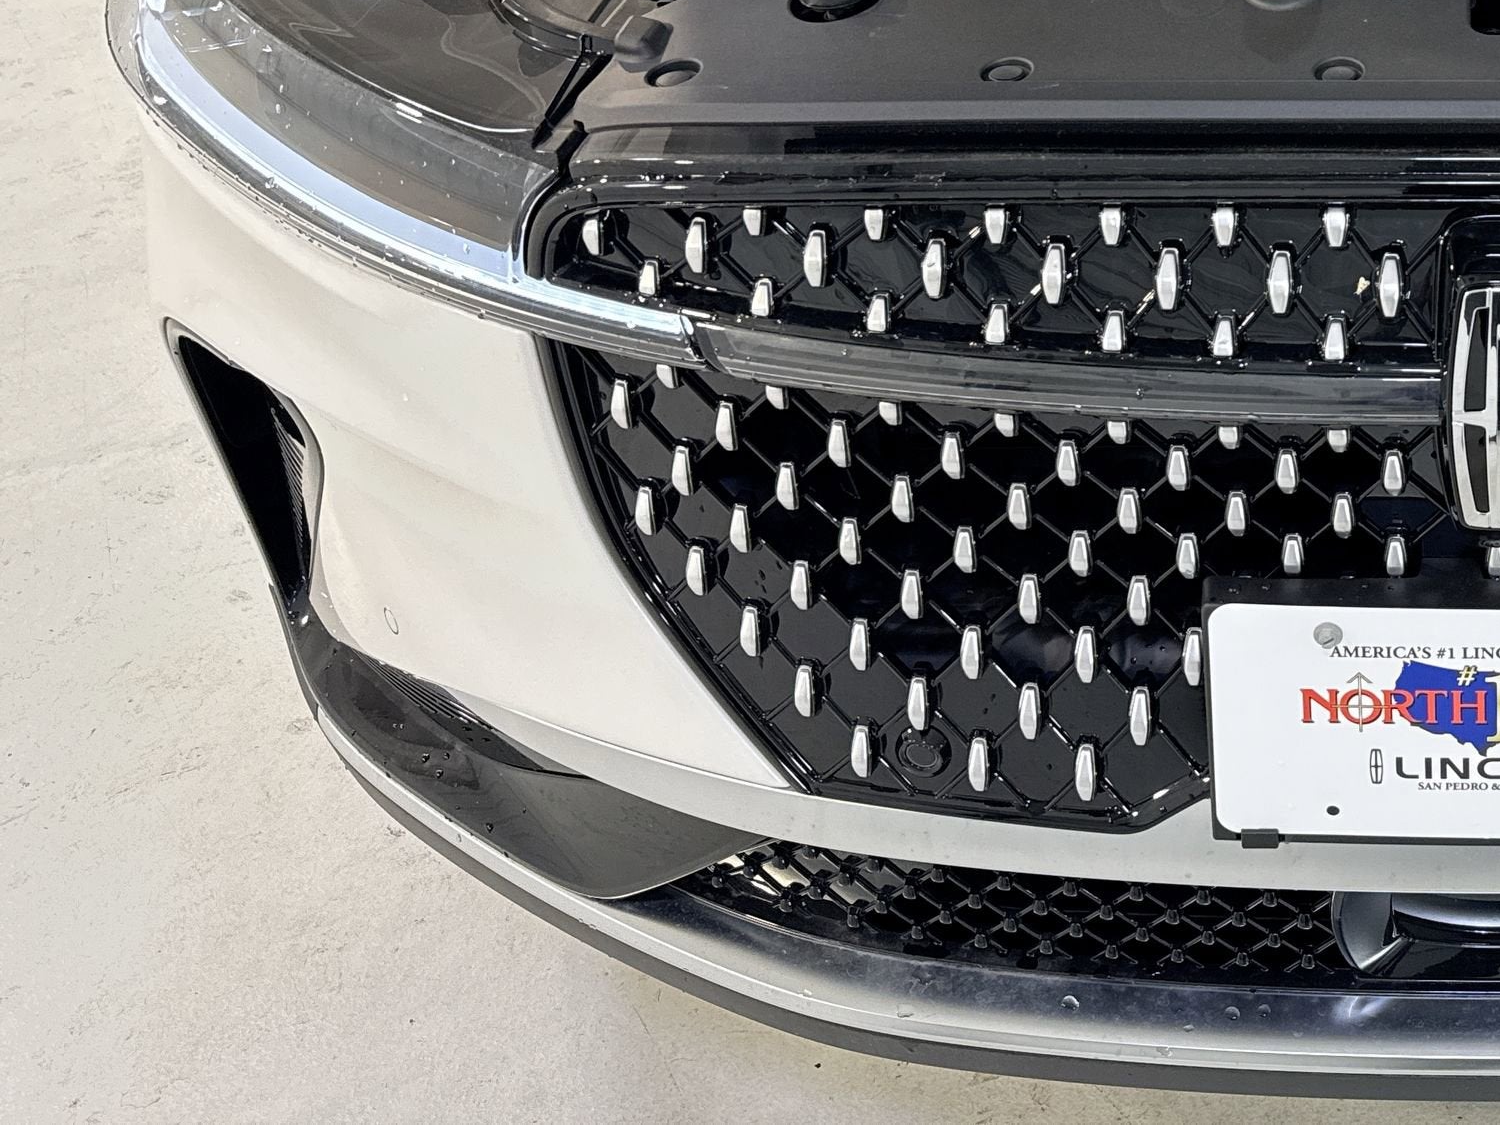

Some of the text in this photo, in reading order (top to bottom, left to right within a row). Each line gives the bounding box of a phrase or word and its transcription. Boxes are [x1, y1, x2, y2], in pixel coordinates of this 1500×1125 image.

[1329, 645, 1432, 659] AMERICA'S
[1436, 647, 1456, 659] #1
[1300, 688, 1488, 725] NORTH
[1417, 781, 1442, 791] SAN
[1445, 782, 1489, 791] PEDRO
